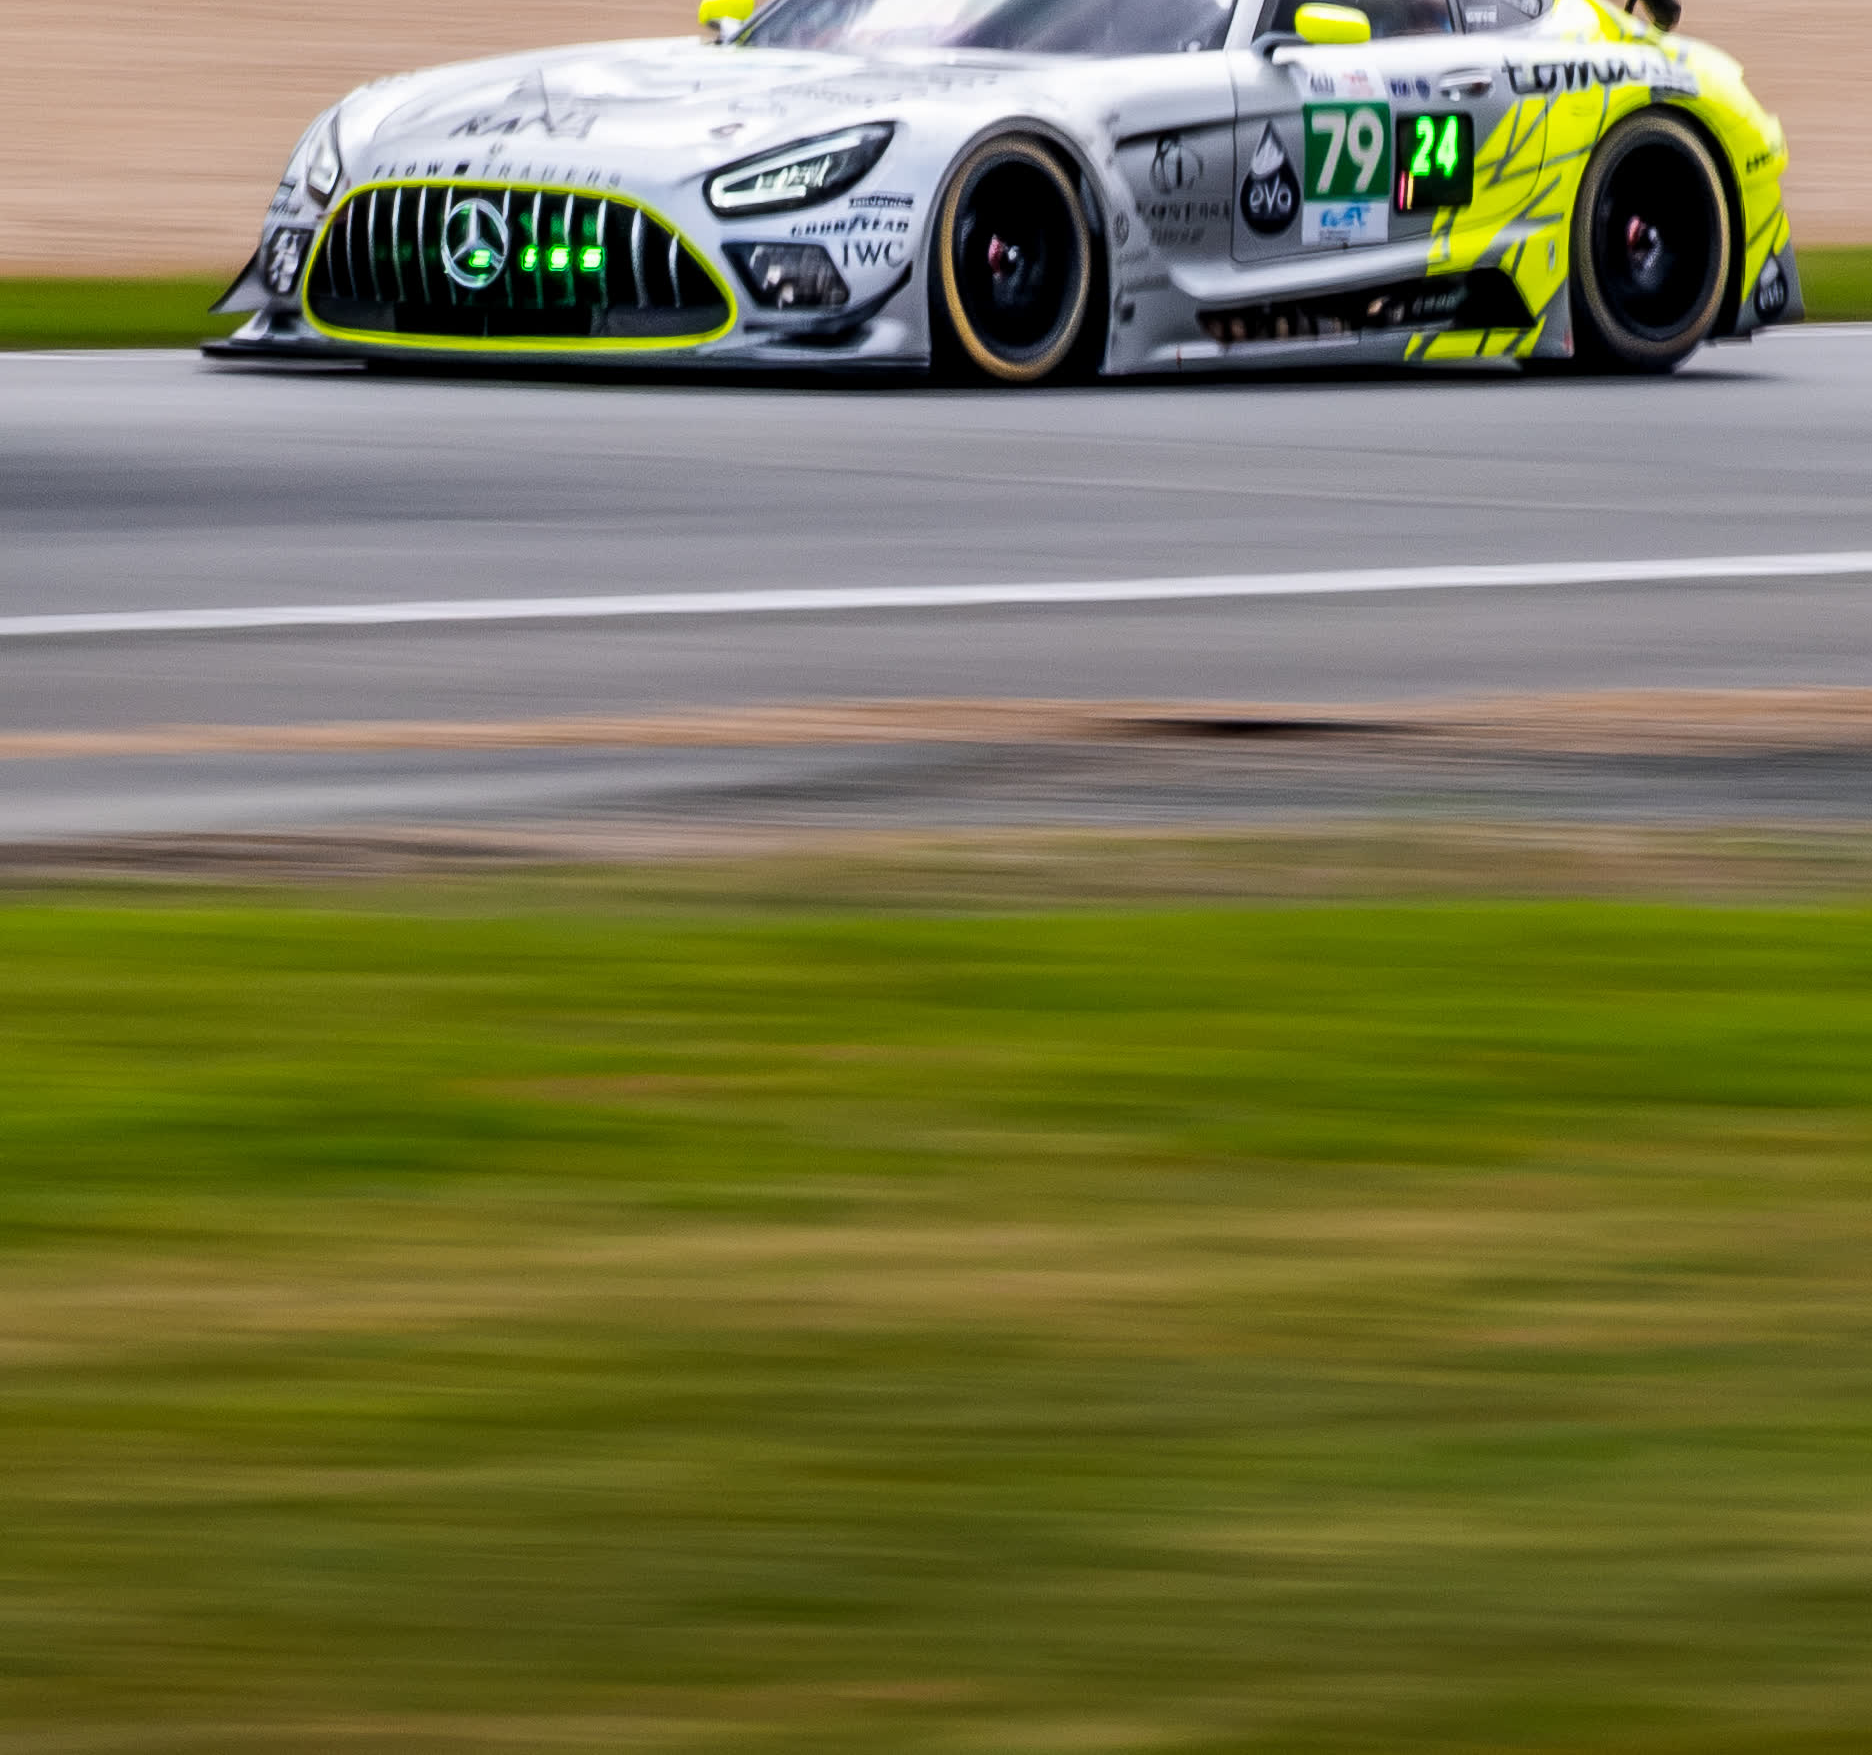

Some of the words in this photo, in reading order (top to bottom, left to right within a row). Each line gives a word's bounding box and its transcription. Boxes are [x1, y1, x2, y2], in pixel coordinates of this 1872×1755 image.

[1311, 107, 1384, 195] 79
[1411, 115, 1459, 178] 24
[842, 239, 905, 270] IWC
